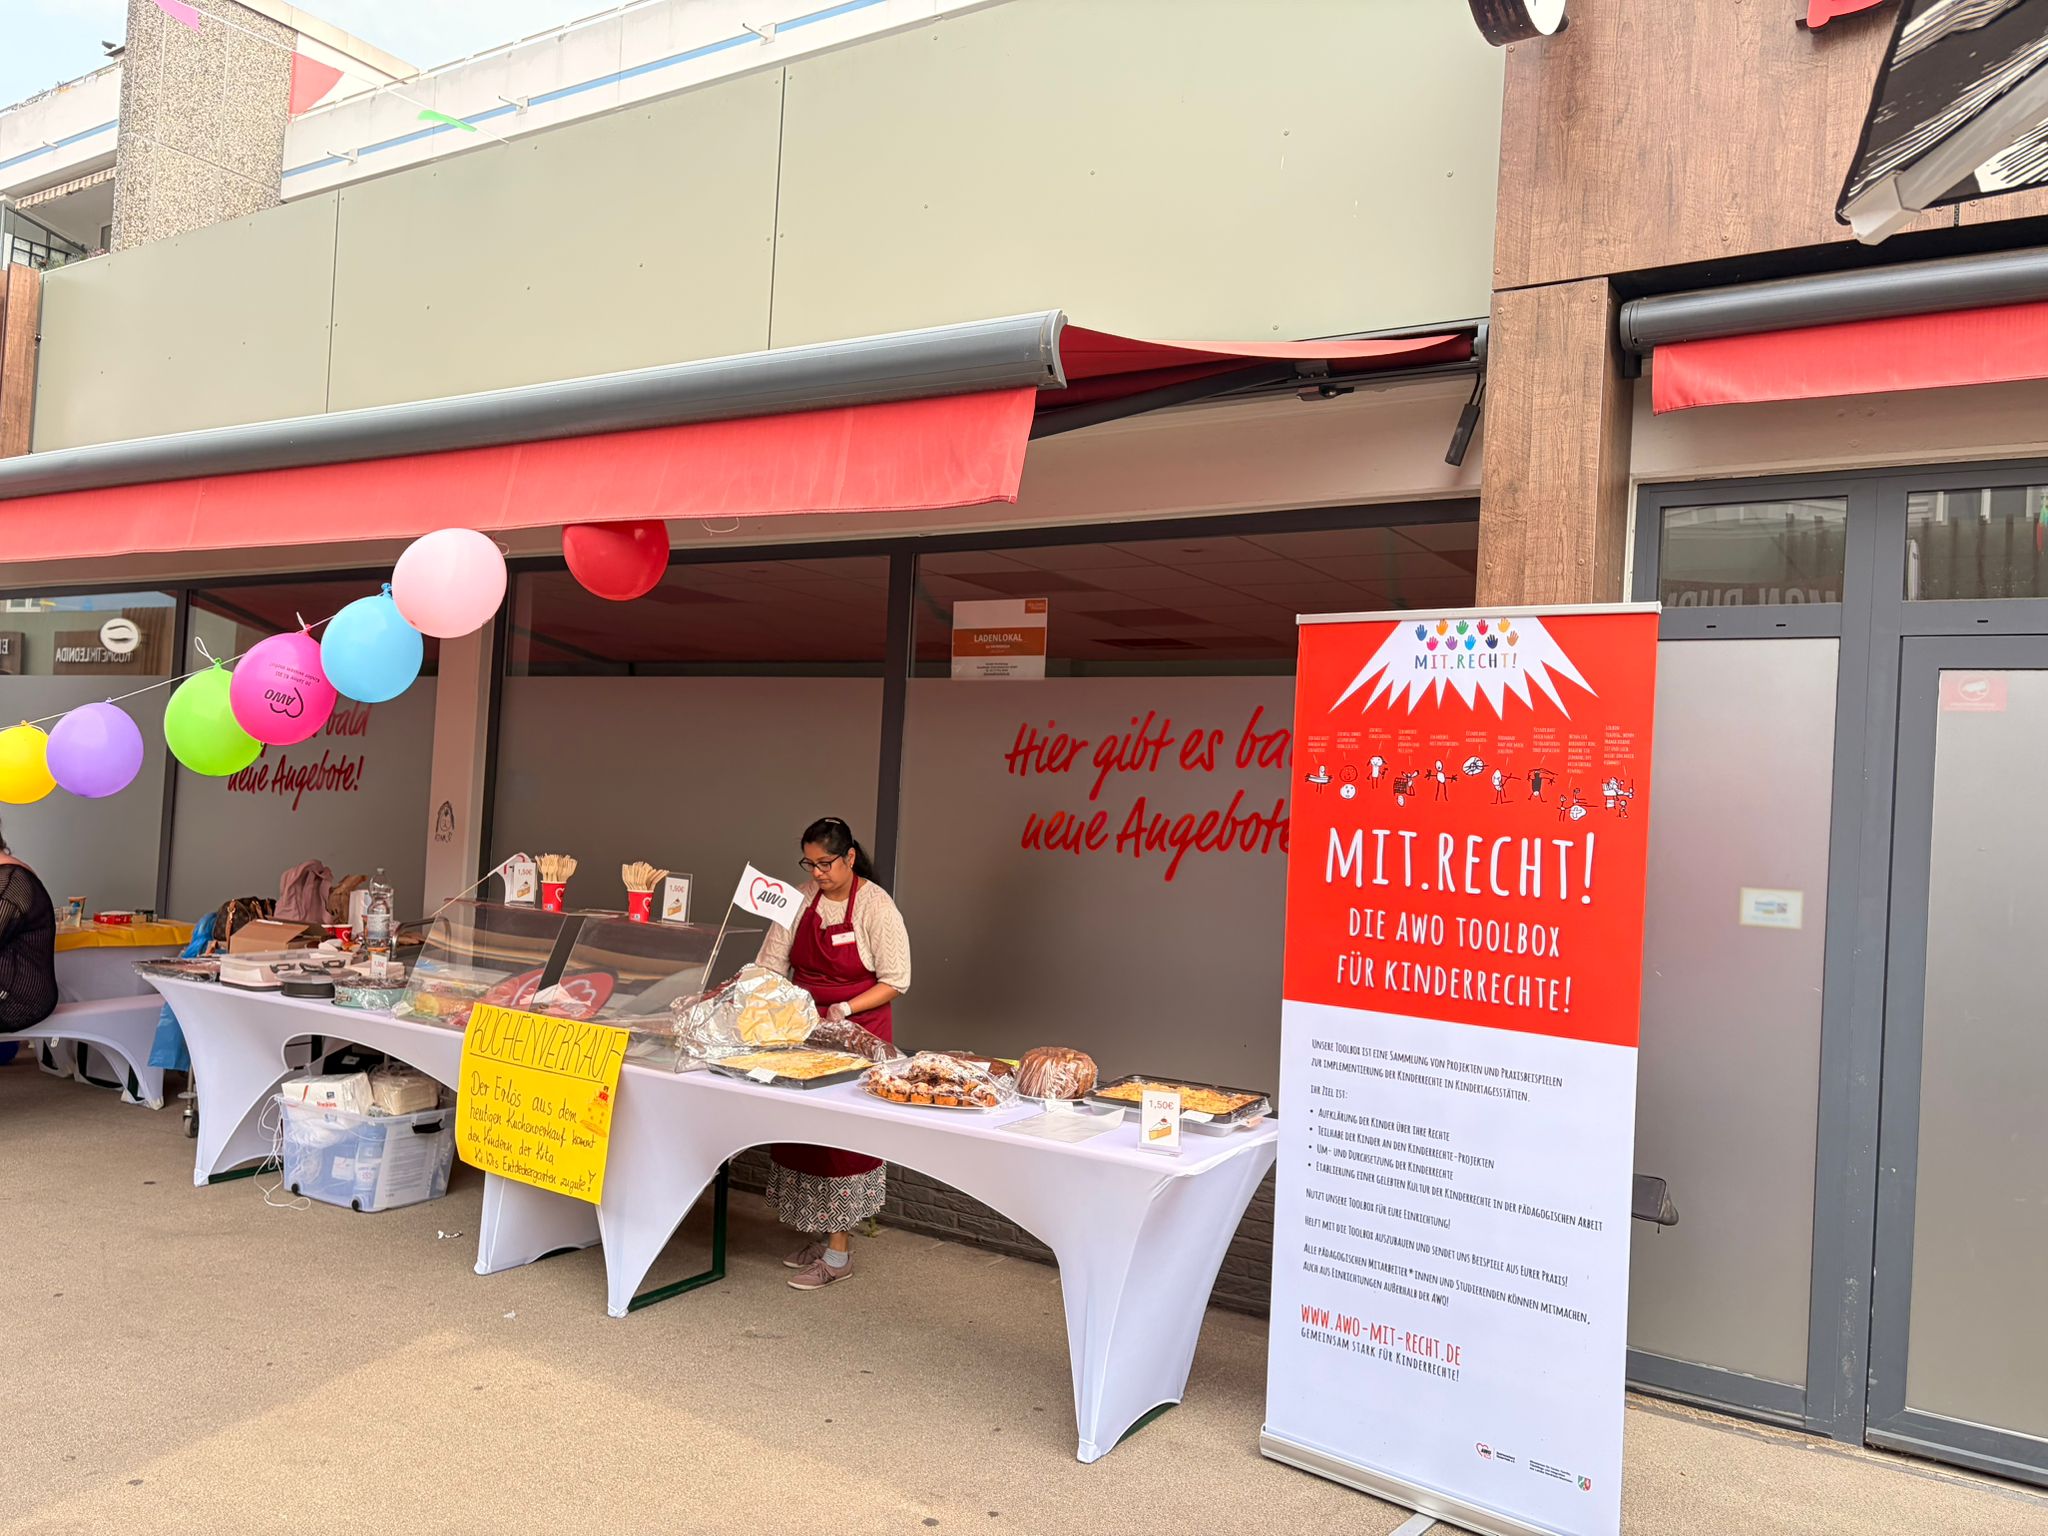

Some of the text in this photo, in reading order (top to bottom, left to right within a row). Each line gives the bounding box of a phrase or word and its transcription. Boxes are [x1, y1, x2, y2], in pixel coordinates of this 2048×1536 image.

[974, 633, 1023, 643] LADENLOKAL
[1415, 652, 1518, 671] MIT.RECHT!
[264, 688, 296, 706] AWO
[1004, 705, 1294, 801] Hier gibt es ba
[227, 749, 365, 811] neue Angebote!
[1021, 810, 1108, 855] neue
[518, 868, 533, 876] 1,50€
[1325, 826, 1596, 905] MIT.RECHT!
[669, 884, 685, 894] 1,50€
[756, 890, 788, 909] AWO
[1349, 907, 1560, 958] DIE AWO TOOLBOX
[1337, 950, 1572, 1014] FÜR KINDERRECHTE!
[470, 1005, 626, 1081] KUCHENVERKAUF
[1311, 1038, 1563, 1087] UNSERE TOOLBOX IST EINE SAMMLUNG VON PROJEKTEN UND PRAXISBEISPIELEN
[1310, 1084, 1321, 1094] IHR
[1322, 1086, 1334, 1098] ZIEL
[1311, 1058, 1322, 1068] ZUR
[1324, 1060, 1384, 1078] IMPLEMENTIERUNG
[1385, 1069, 1396, 1080] DER
[1397, 1070, 1443, 1088] KINDERRECHTE
[1444, 1078, 1454, 1089] IN
[471, 1070, 577, 1123] Der Erlös aus dem
[1149, 1099, 1174, 1110] 1,50€
[469, 1098, 502, 1132] heutigen
[506, 1107, 566, 1147] Kuchenverkauf
[1318, 1108, 1450, 1142] AUFKLÄRUNG DER KINDER ÜBER IHRE RECHTE
[1318, 1126, 1344, 1138] TEILHABE
[1345, 1132, 1356, 1142] DER
[1357, 1133, 1381, 1147] KINDER
[1382, 1138, 1392, 1149] AN
[1393, 1140, 1406, 1152] DEN
[468, 1126, 554, 1166] den Kindern der Kita
[1333, 1148, 1347, 1158] UND
[1348, 1150, 1394, 1168] DURCHSETZUNG
[1396, 1160, 1406, 1171] DER
[1408, 1162, 1454, 1180] KINDERRECHTE
[1306, 1188, 1324, 1200] NUTZT
[1326, 1194, 1348, 1206] UNSERE
[1349, 1198, 1374, 1212] TOOLBOX
[1376, 1203, 1386, 1215] FÜR
[1388, 1206, 1402, 1219] EURE
[1316, 1161, 1602, 1232] ETABLIERUNG EINER GELEBTEN KULTUR DER KINDERRECHTE IN DER PÄDAGOGISCHEN ARBEIT
[1304, 1216, 1568, 1288] HELFT MIT DIE TOOLBOX AUSZUBAUEN UND SENDET UNS BEISPIELE AUS EURER PRAXIS!
[1303, 1261, 1318, 1274] AUCH
[1320, 1266, 1330, 1276] AUS
[1332, 1268, 1382, 1290] EINRICHTUNGEN
[1418, 1290, 1430, 1301] DER
[1432, 1294, 1449, 1307] AWO!
[1304, 1243, 1317, 1255] ALLE
[1318, 1246, 1367, 1268] PÄDAGOGISCHEN
[1440, 1277, 1454, 1289] UND
[1456, 1280, 1506, 1301] STUDIERENDEN
[1508, 1293, 1539, 1310] KÖNNEN
[1300, 1326, 1460, 1382] GEMEINSAM STARK FÜR KINDERRECHTE!
[1301, 1303, 1461, 1366] WWW.AWO-MIT-RECHT.DE
